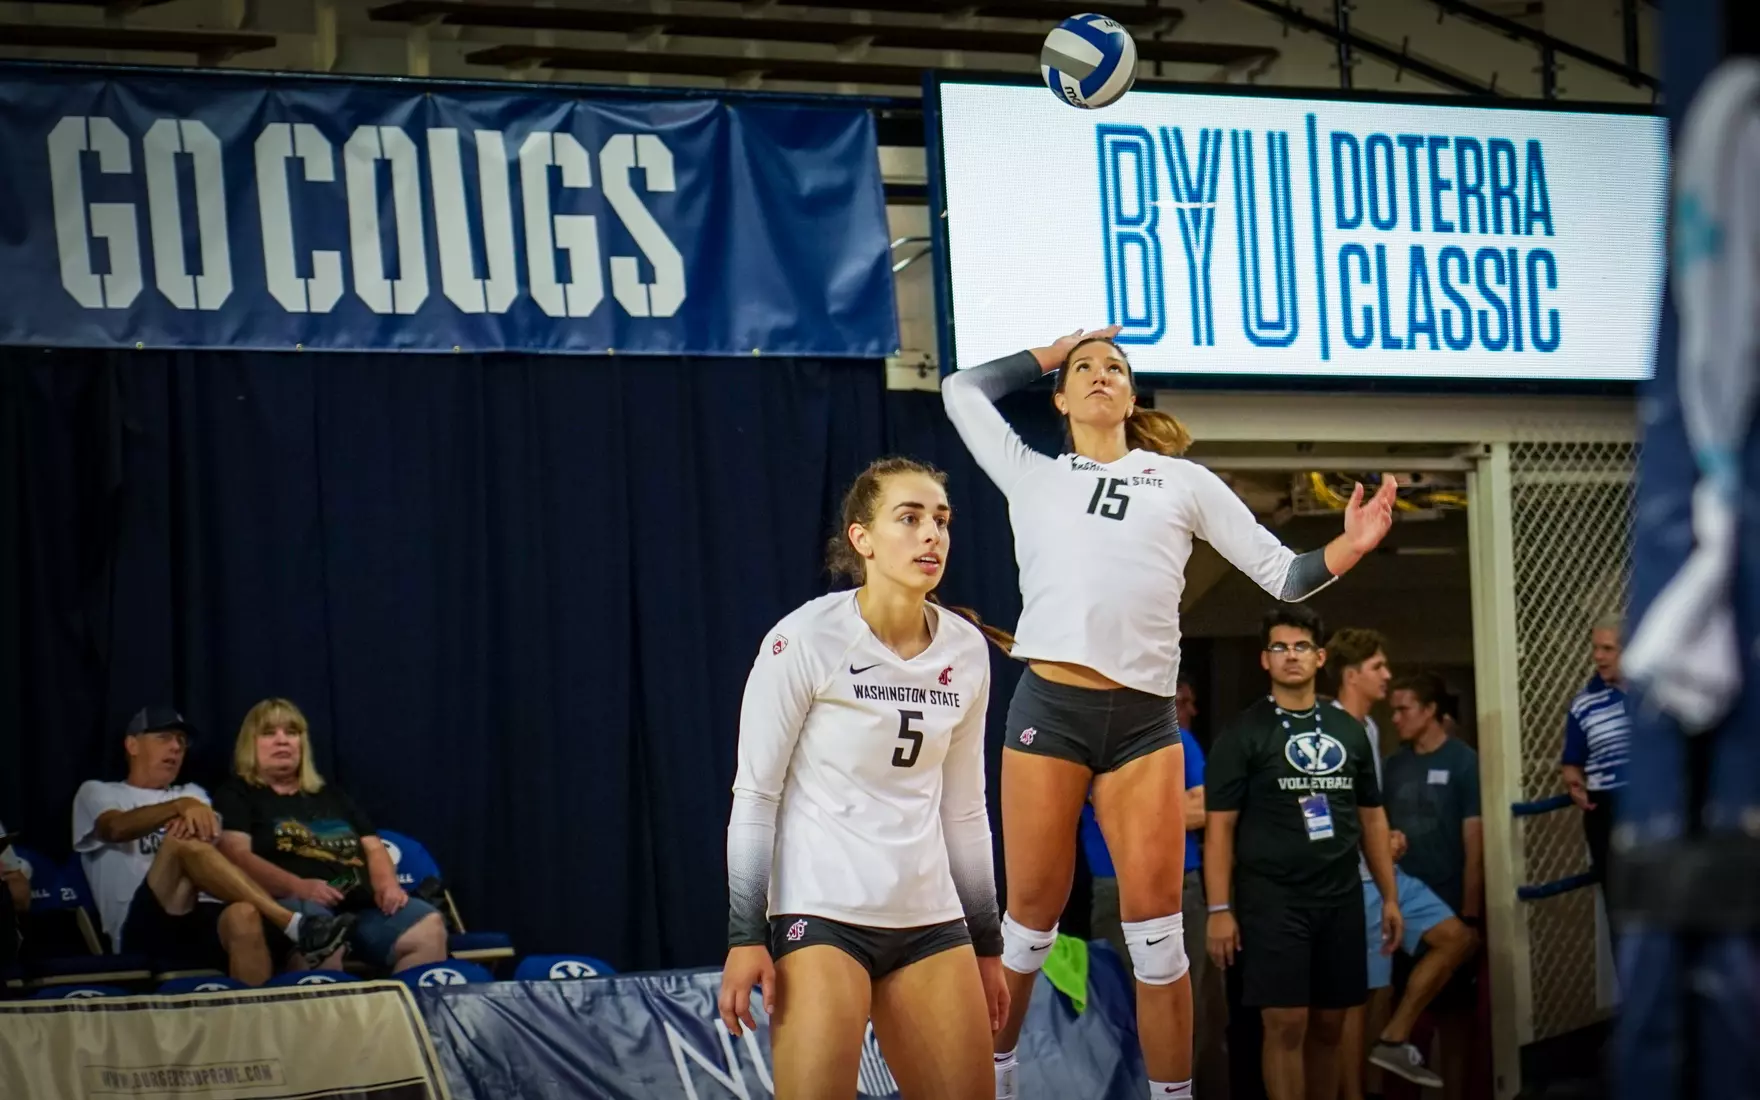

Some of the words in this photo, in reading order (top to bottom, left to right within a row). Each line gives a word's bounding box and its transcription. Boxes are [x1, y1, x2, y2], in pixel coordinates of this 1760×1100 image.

[1330, 131, 1555, 236] DOTERRA
[48, 116, 234, 310] GO
[254, 122, 687, 317] COUGS
[1096, 123, 1300, 347] BYU
[1338, 243, 1560, 352] CLASSIC
[1086, 477, 1130, 521] 15
[1132, 476, 1164, 488] STATE
[853, 684, 927, 703] WASHINGTON
[930, 690, 960, 708] STATE
[891, 709, 924, 767] 5
[1278, 776, 1353, 790] VOLLEYBALL
